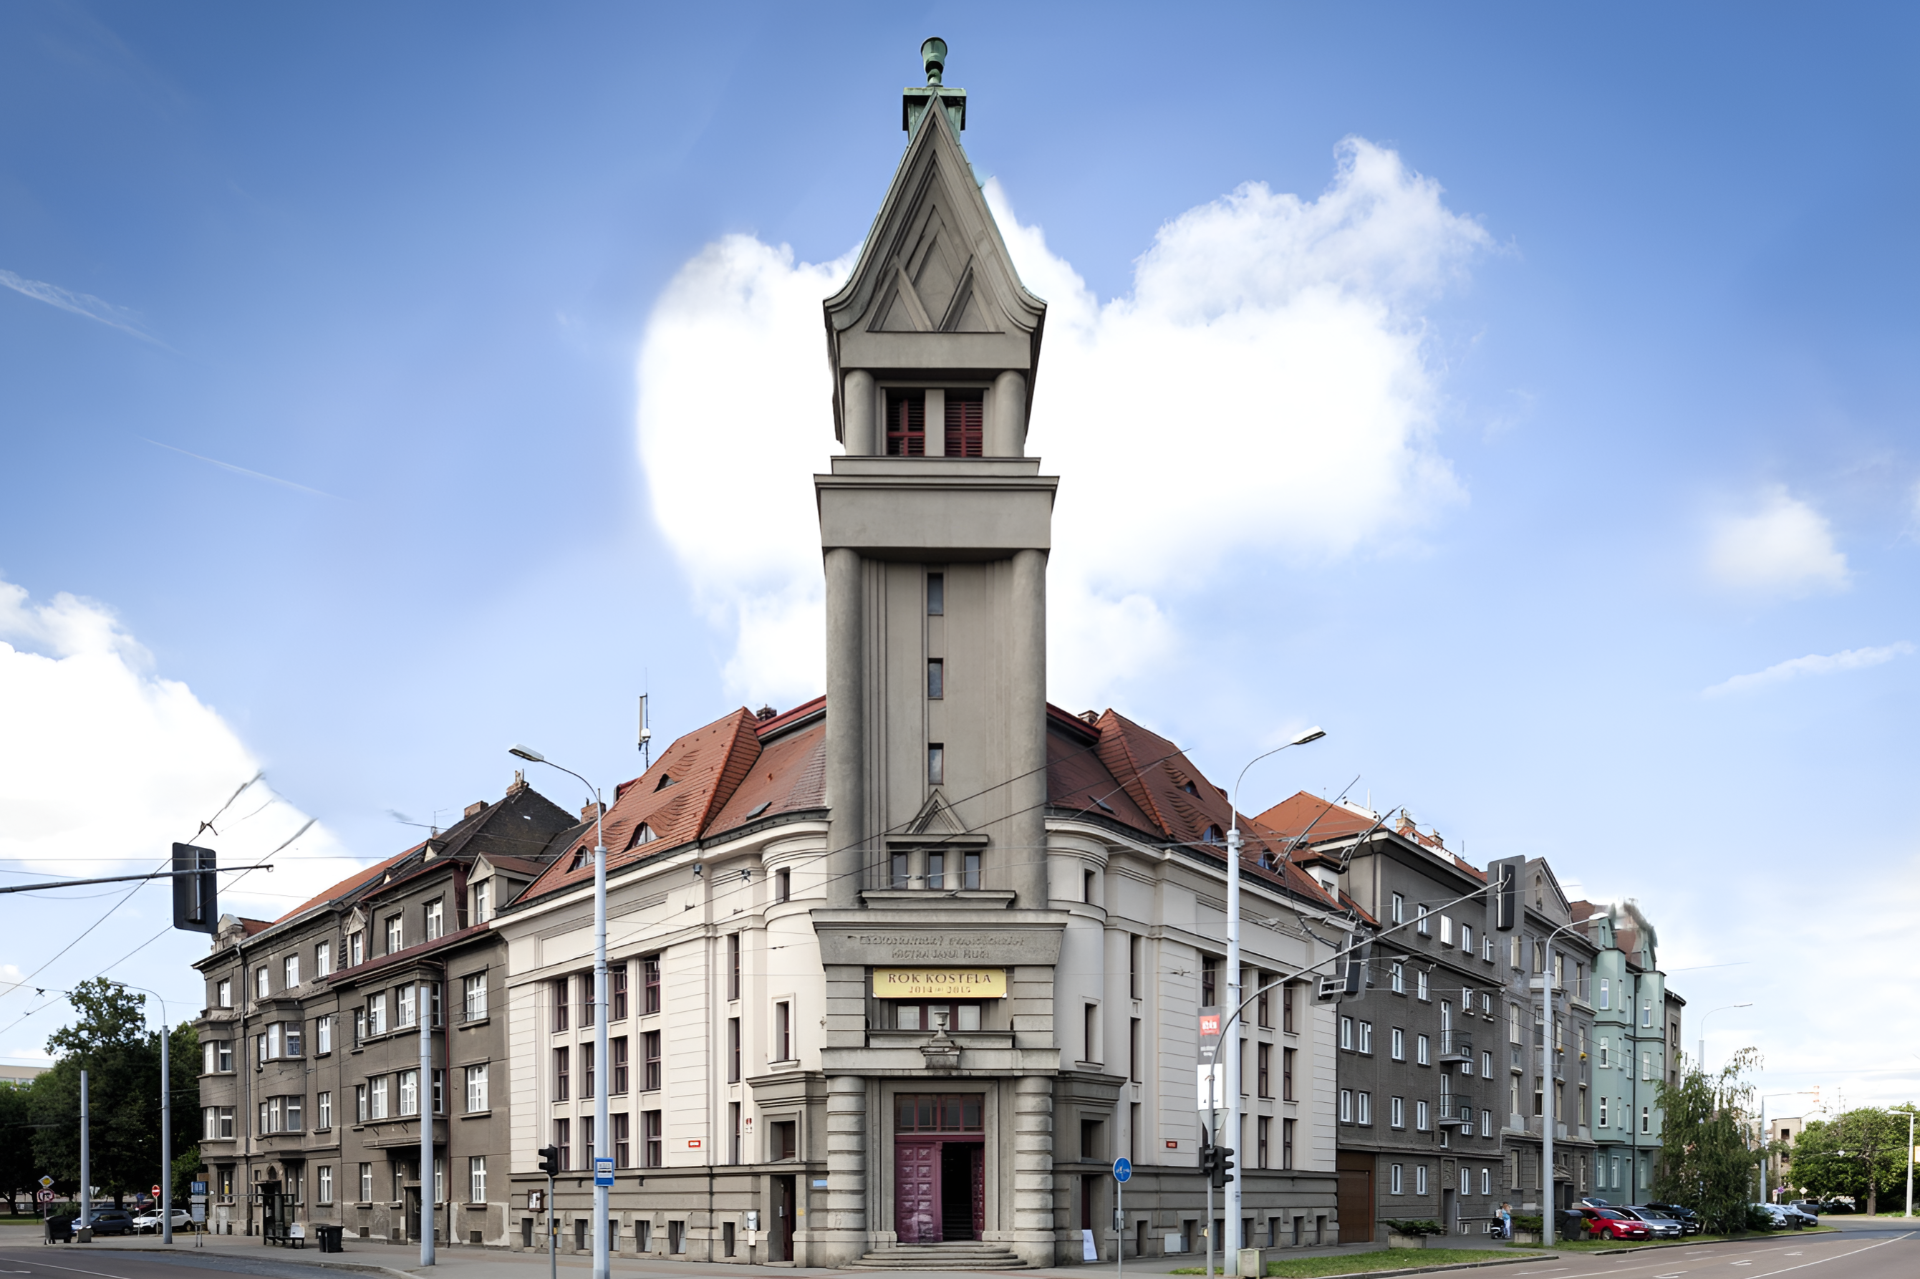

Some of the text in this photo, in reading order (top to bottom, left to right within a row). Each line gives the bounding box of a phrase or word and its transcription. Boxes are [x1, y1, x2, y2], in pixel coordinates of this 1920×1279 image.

[888, 973, 992, 984] ROK KOSTELA
[909, 986, 933, 994] 2014
